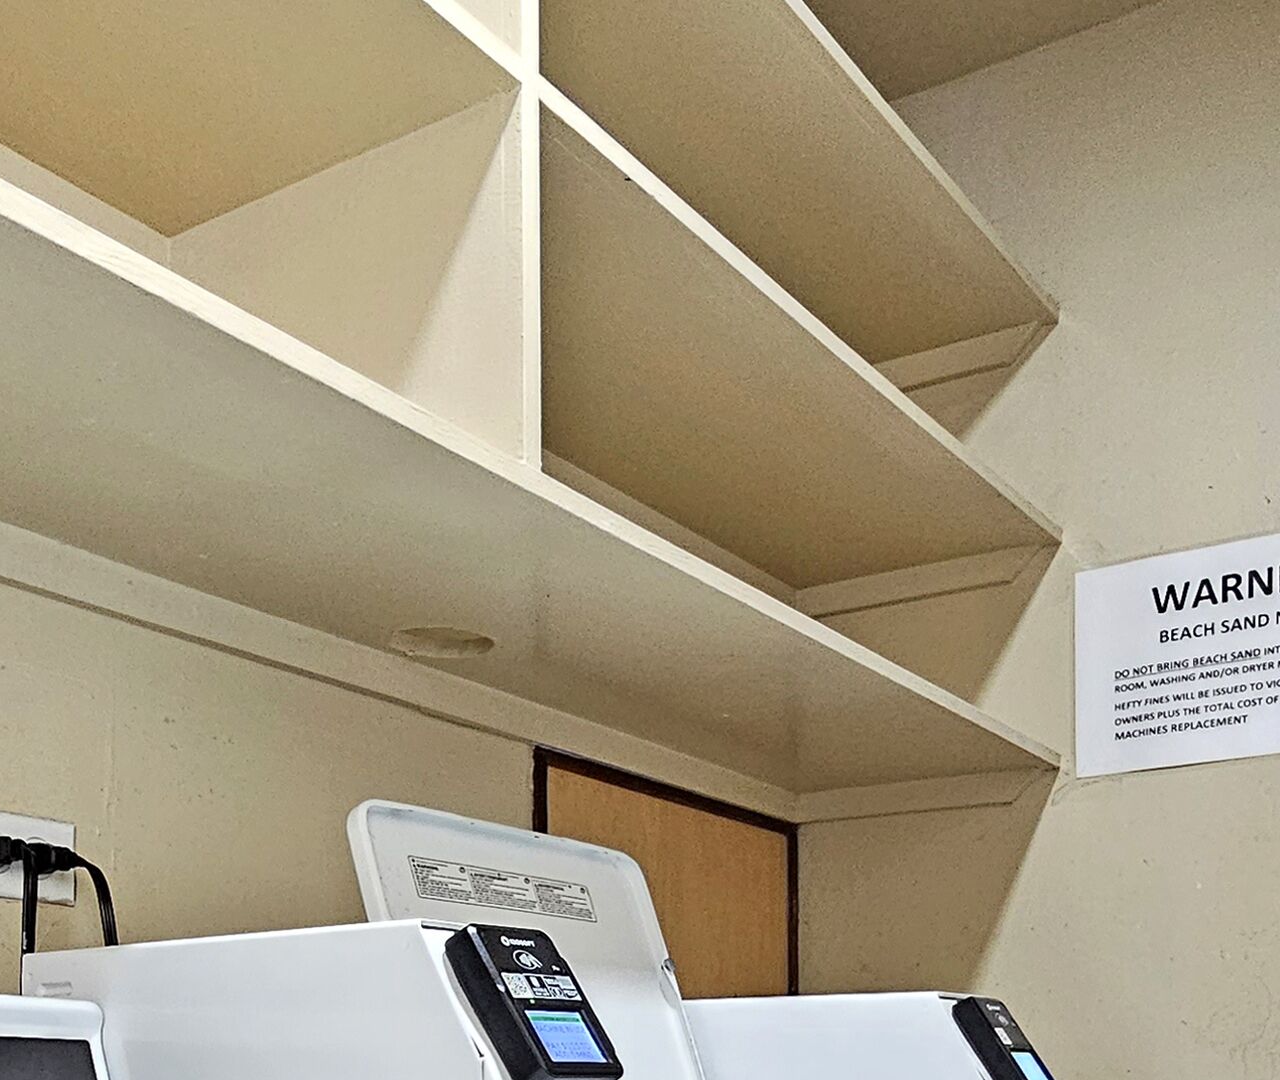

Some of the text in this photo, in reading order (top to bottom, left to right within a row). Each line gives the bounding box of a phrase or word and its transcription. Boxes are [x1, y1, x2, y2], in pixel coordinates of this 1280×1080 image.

[1159, 622, 1215, 643] BEACH
[1220, 614, 1269, 633] SAND
[1114, 669, 1130, 680] DO
[1132, 664, 1154, 675] NOT
[1156, 659, 1189, 673] BRING
[1192, 653, 1228, 666] BEACH
[1231, 648, 1261, 661] SAND
[1114, 681, 1147, 693] ROOM,
[1149, 673, 1196, 687] WASHING
[1198, 666, 1239, 680] AND/OR
[1242, 661, 1275, 674] DRYER
[1114, 699, 1142, 712] HEFTY
[1144, 695, 1170, 706] FINES
[1172, 692, 1195, 702] WILL
[1198, 689, 1210, 699] BE
[1212, 683, 1247, 697] ISSUED
[1250, 682, 1264, 691] TO
[1114, 712, 1155, 727] OWNERS
[1157, 708, 1181, 719] PLUS
[1182, 706, 1201, 716] THE
[1204, 701, 1235, 713] TOTAL
[1237, 697, 1263, 710] COST
[1265, 695, 1279, 705] OF
[1114, 714, 1248, 741] MACHINES REPLACEMENT
